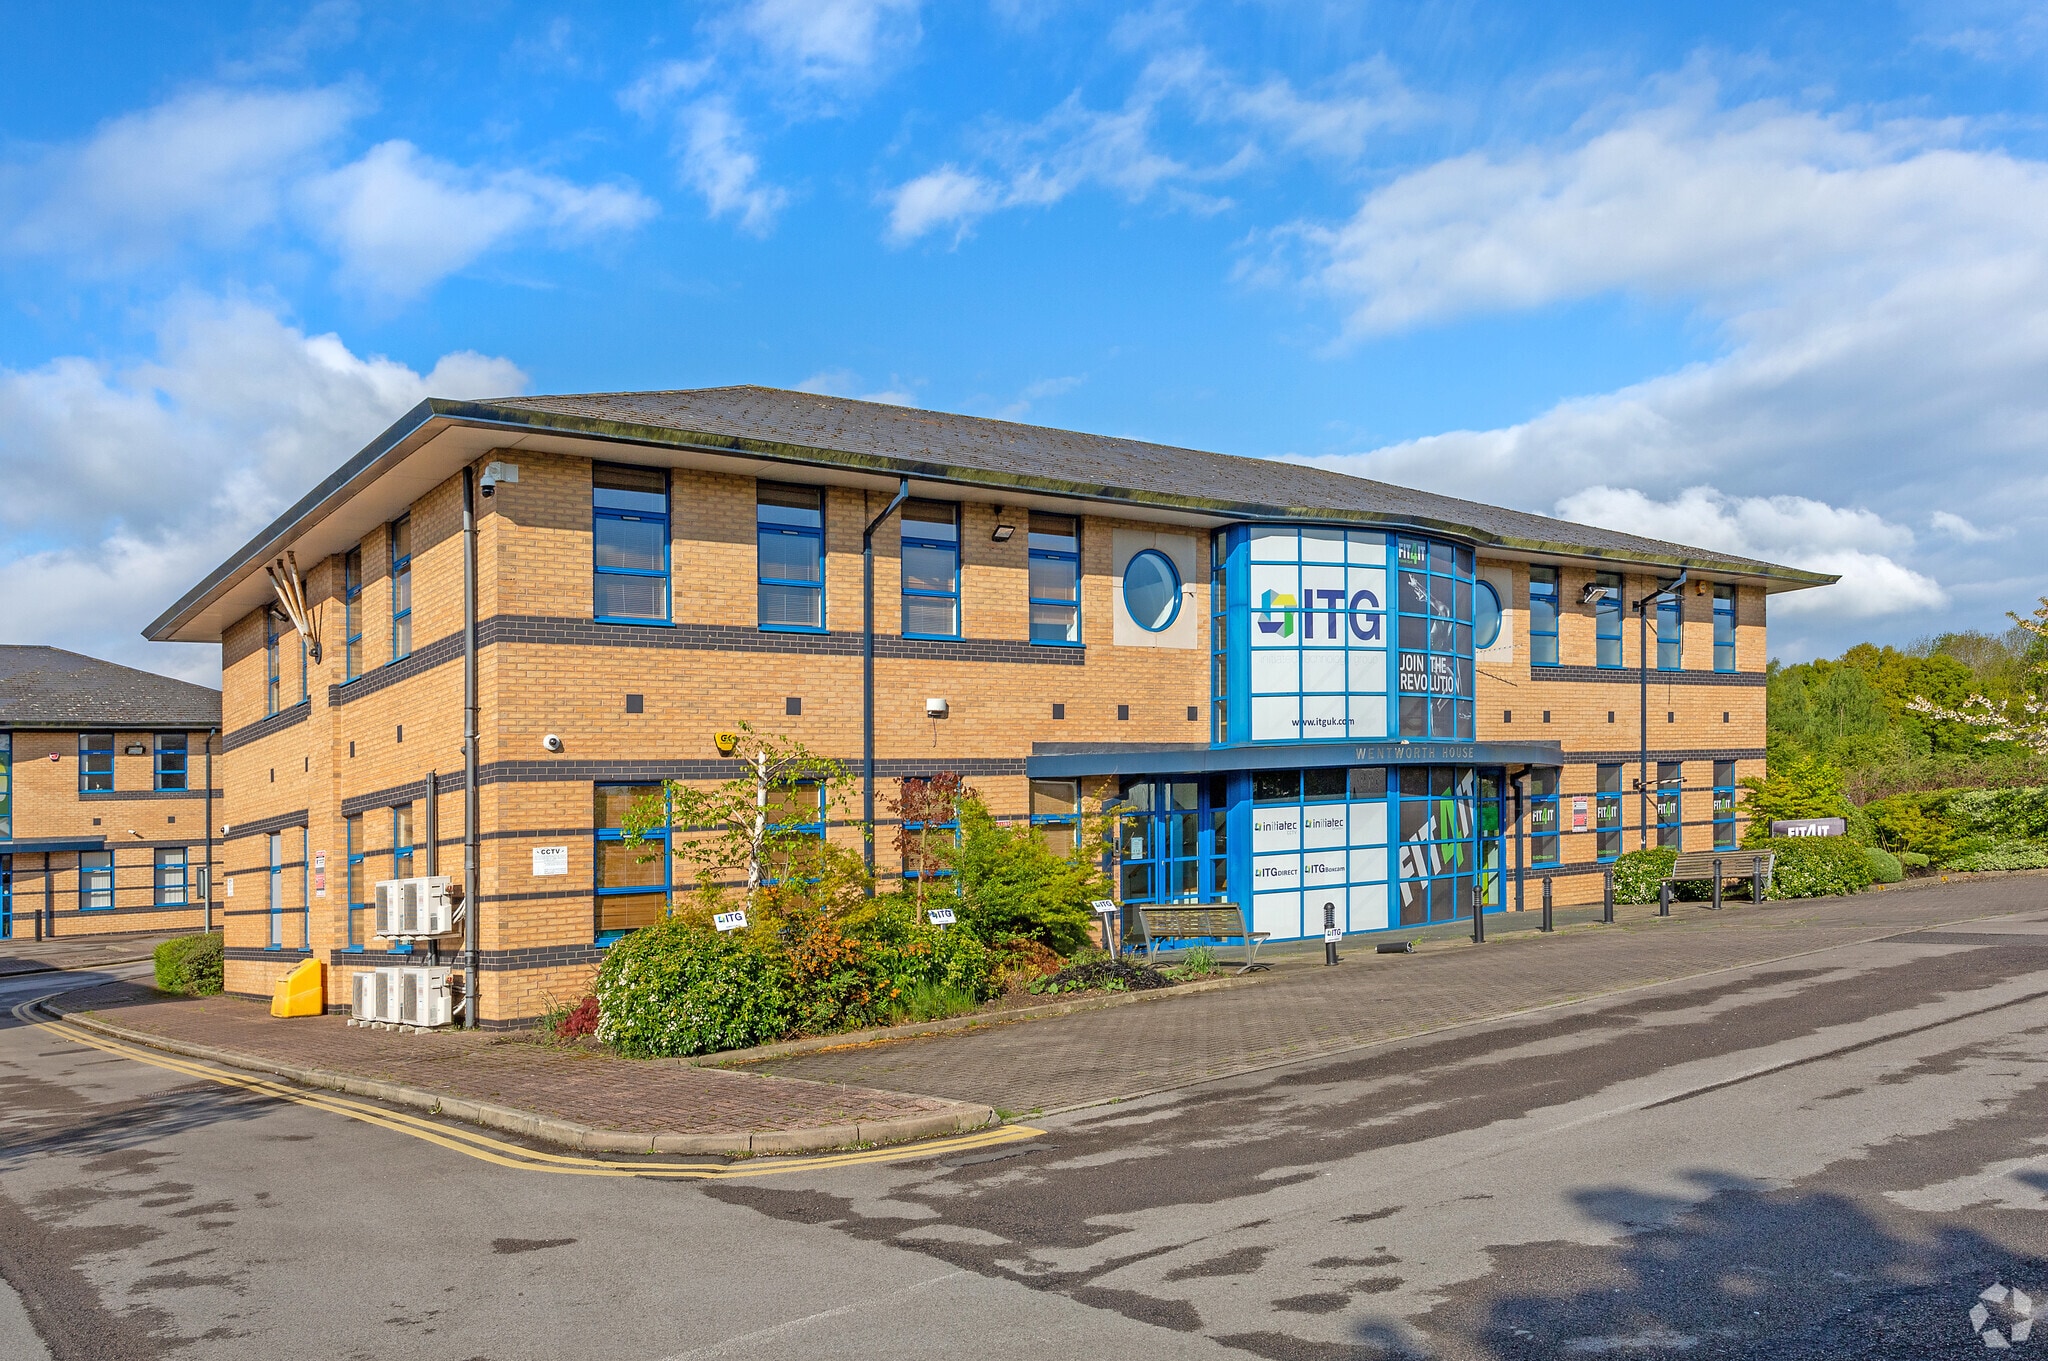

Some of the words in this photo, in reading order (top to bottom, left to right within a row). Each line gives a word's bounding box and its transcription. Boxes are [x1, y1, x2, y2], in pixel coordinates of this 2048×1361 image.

[1398, 543, 1426, 564] FIT4IT
[1304, 588, 1381, 641] ITG
[1400, 654, 1424, 671] JOIN
[1430, 656, 1447, 673] THE
[1400, 673, 1460, 693] REVOLUTION
[1291, 717, 1355, 727] www.itguk.com
[1355, 747, 1436, 760] WENTWORTH
[1442, 746, 1474, 759] HOUSE
[1532, 807, 1554, 825] FIT4IT
[1597, 804, 1618, 821] FIT4IT
[1657, 801, 1677, 817] FIT4IT
[725, 912, 743, 923] ITG
[937, 909, 952, 918] ITG
[1331, 928, 1342, 937] ITG
